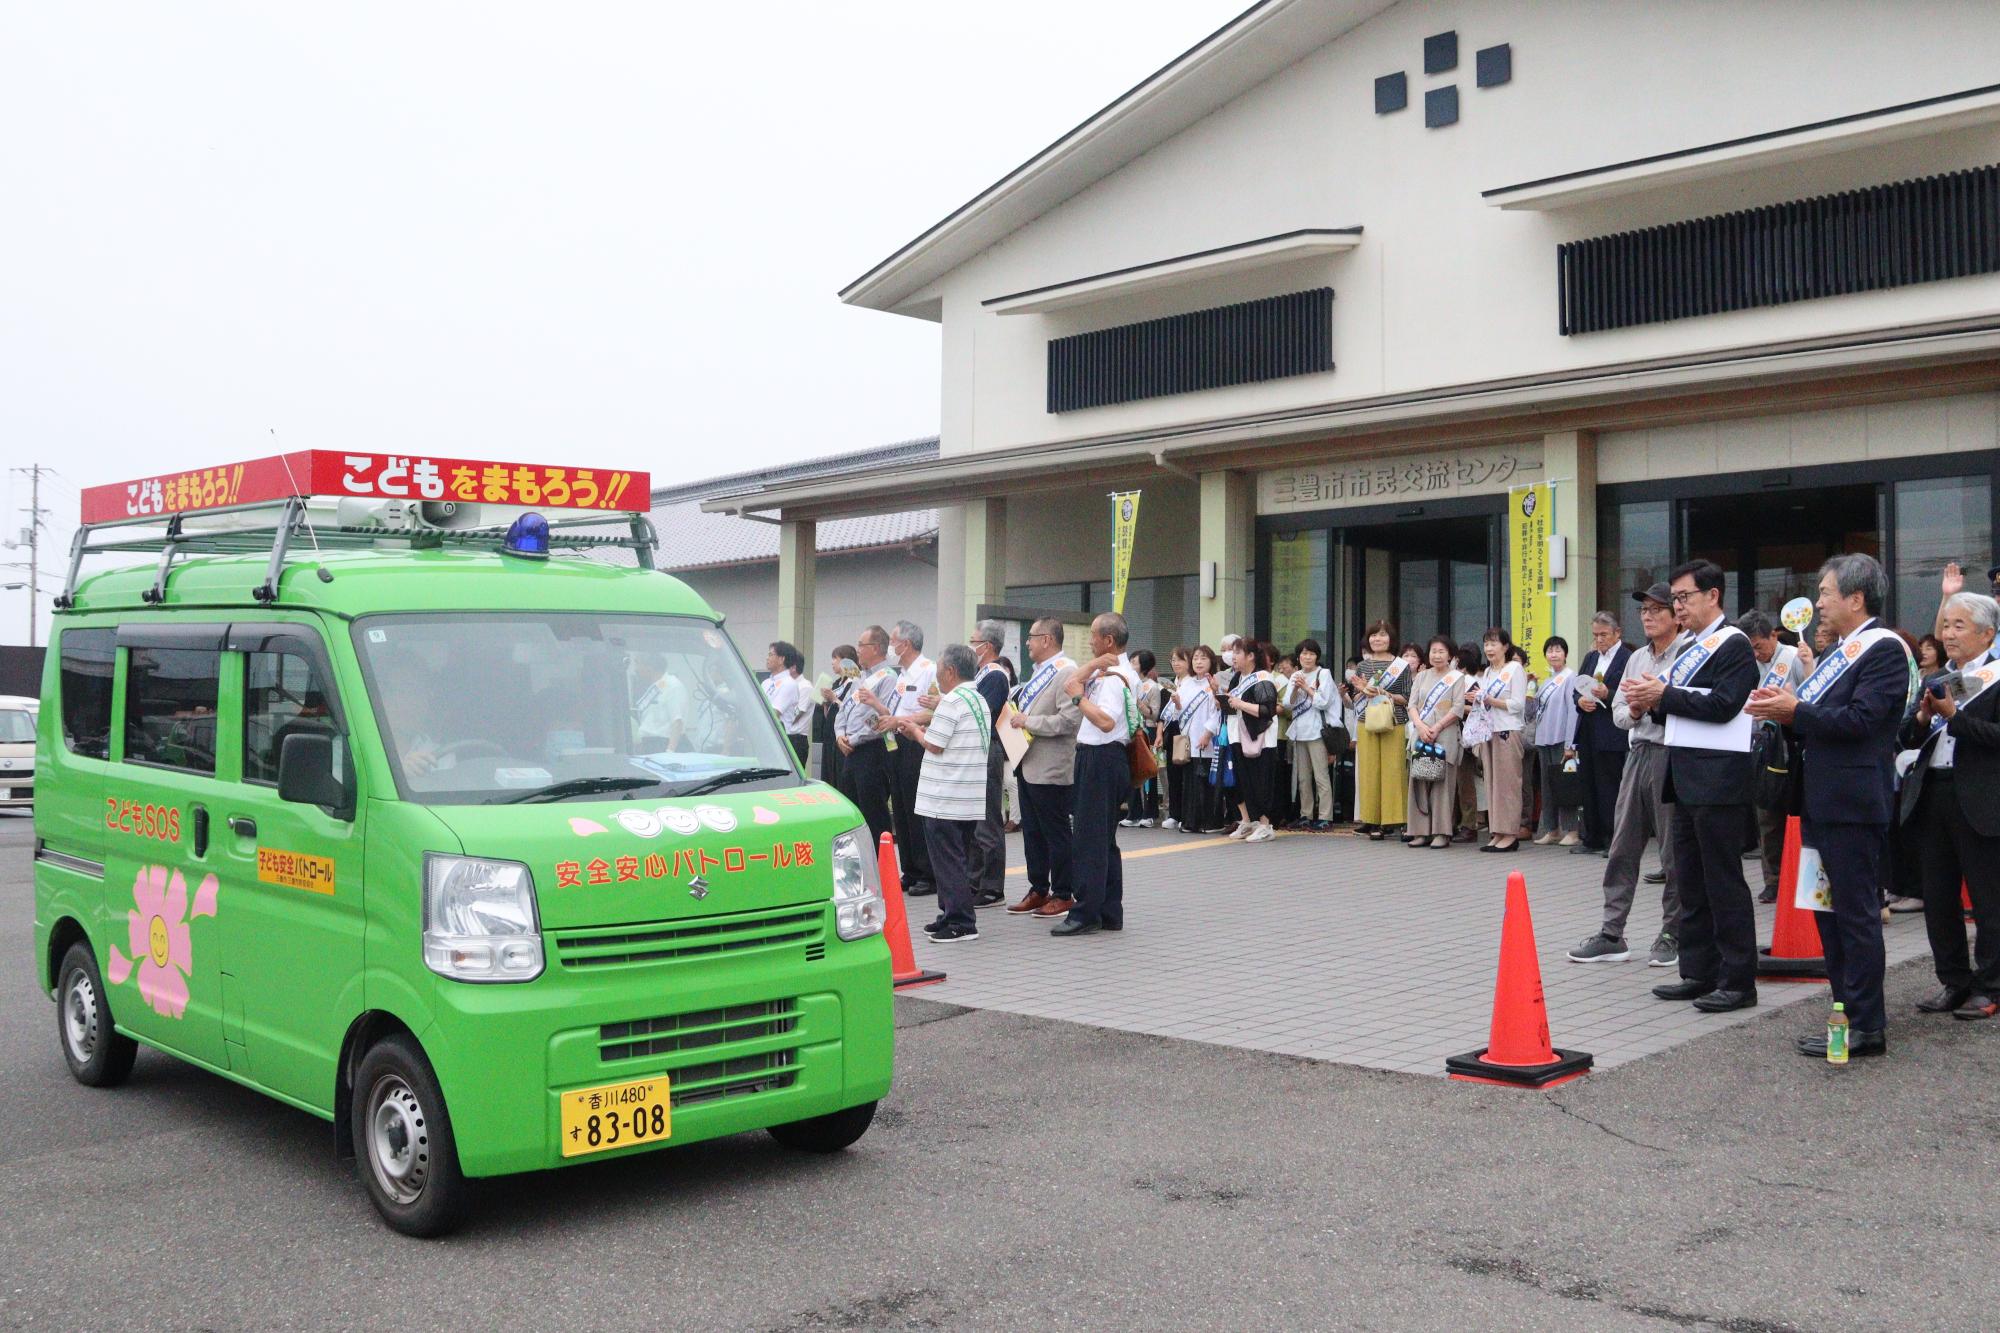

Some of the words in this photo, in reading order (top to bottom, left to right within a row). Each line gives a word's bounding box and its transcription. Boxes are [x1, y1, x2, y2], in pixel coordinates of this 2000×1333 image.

[1274, 454, 1544, 503] 三豊市市民交流センター
[105, 798, 180, 842] こどもSOS
[555, 841, 815, 888] 安全安心パトロール隊
[570, 1125, 582, 1142] す
[588, 1104, 665, 1147] 83-08
